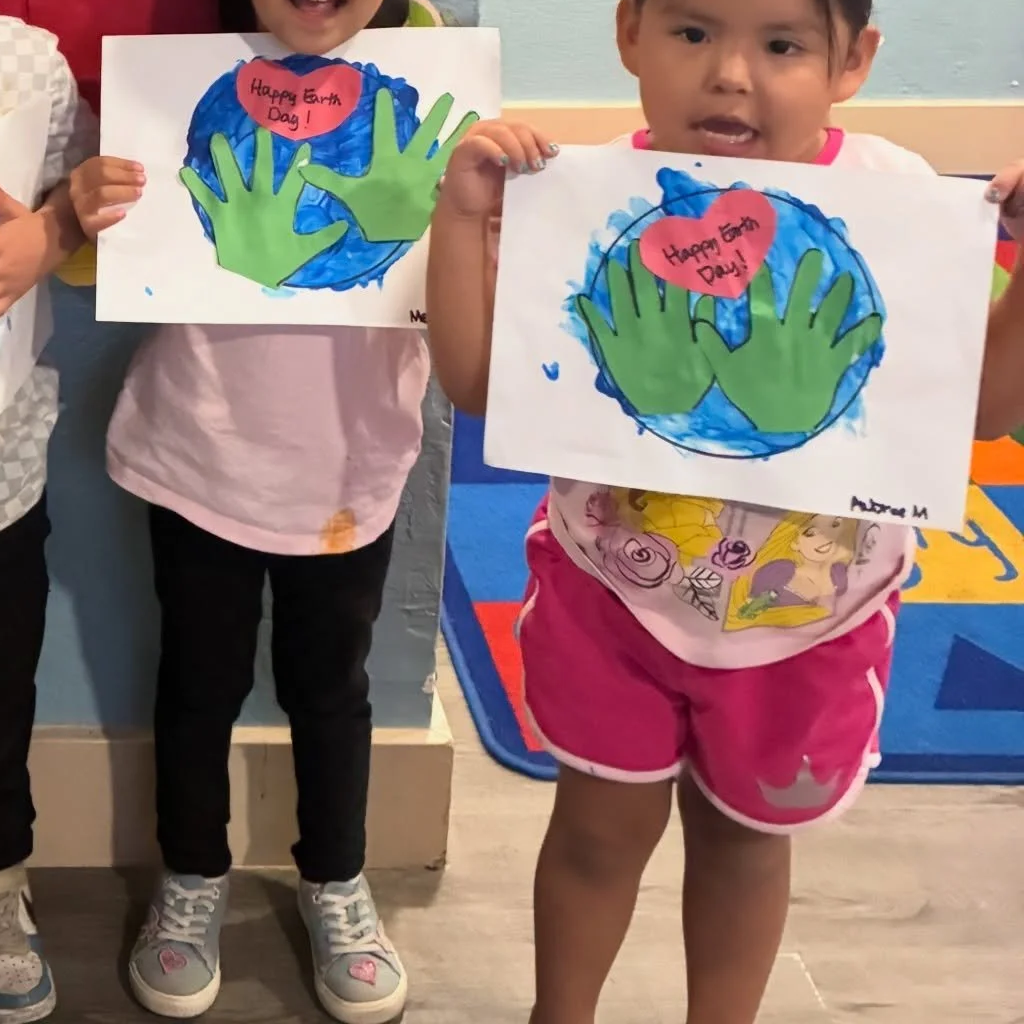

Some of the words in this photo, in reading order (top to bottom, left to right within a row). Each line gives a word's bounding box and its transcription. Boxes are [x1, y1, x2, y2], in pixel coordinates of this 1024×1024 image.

[251, 78, 297, 106] Happy
[303, 88, 342, 107] Earth
[662, 237, 721, 267] Happy
[719, 216, 761, 244] Earth
[696, 249, 749, 287] Day!
